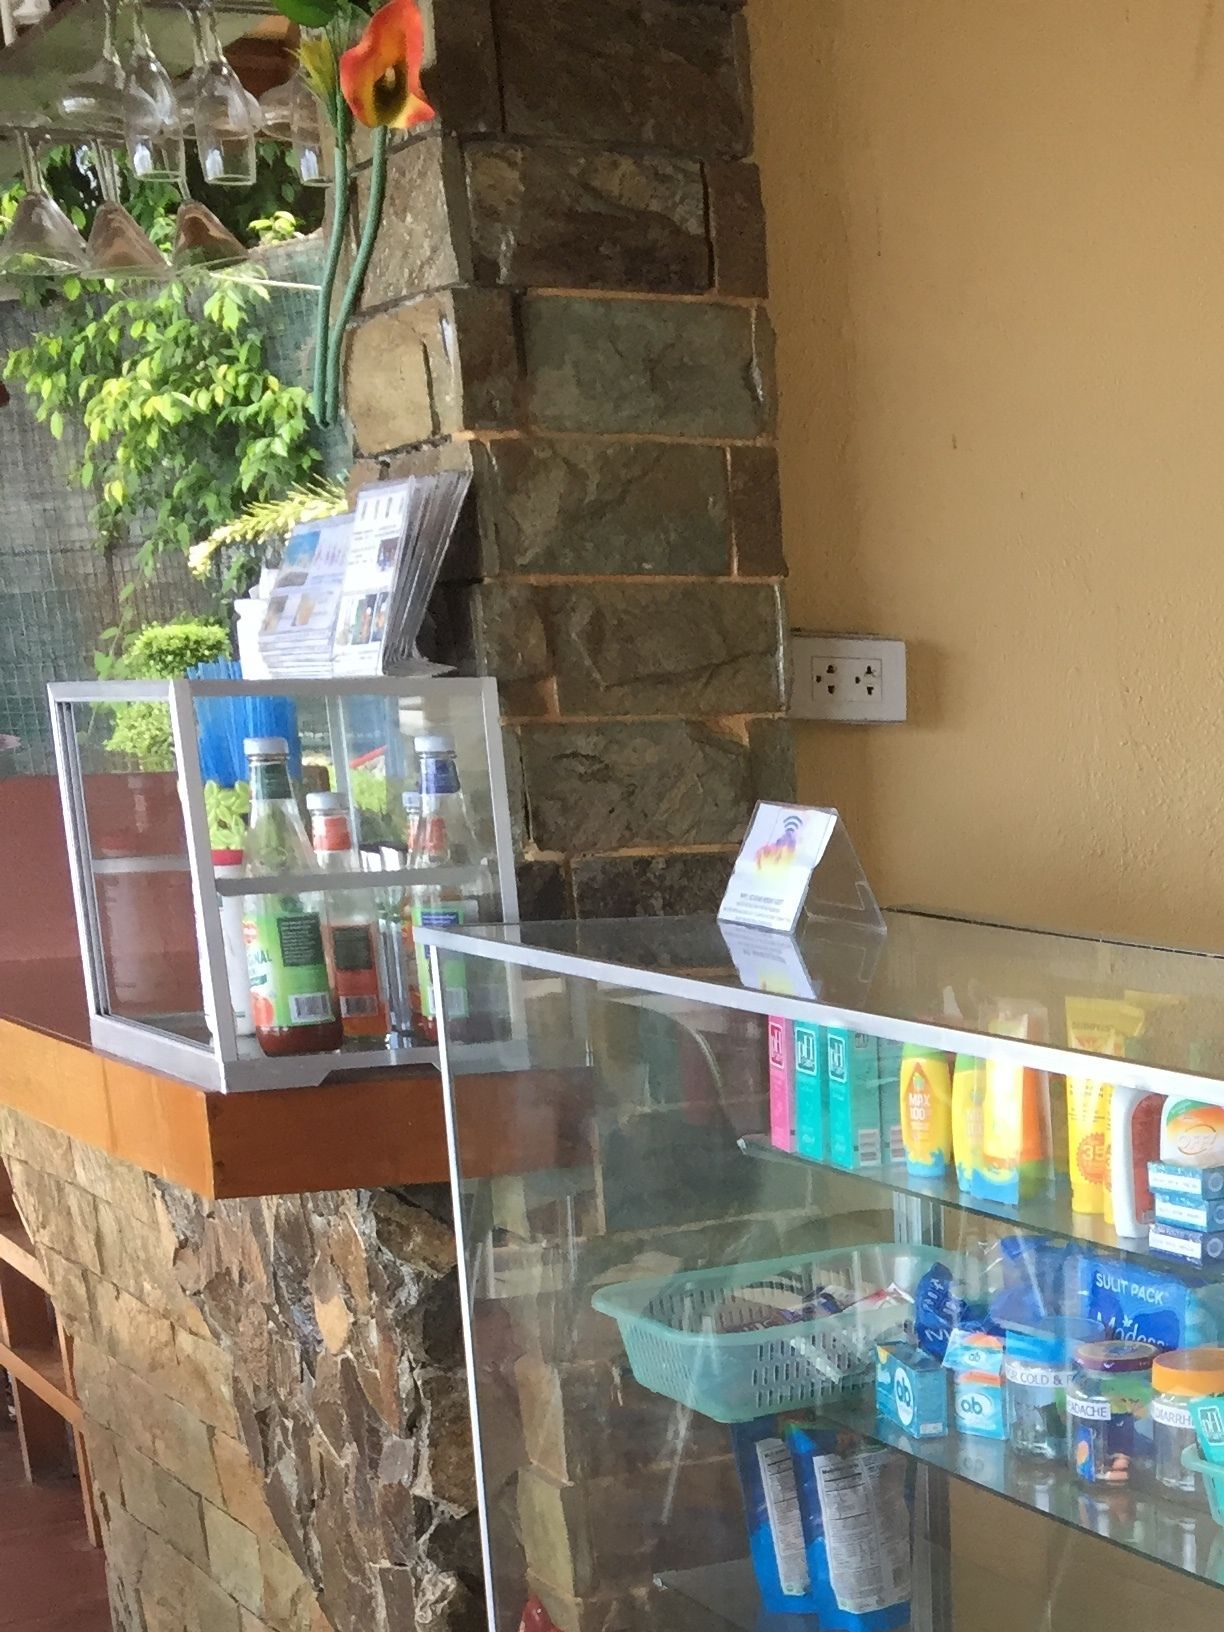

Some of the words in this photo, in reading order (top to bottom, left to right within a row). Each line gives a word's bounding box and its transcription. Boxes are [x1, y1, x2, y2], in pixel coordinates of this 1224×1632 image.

[1095, 1272, 1129, 1292] SULIT
[1130, 1283, 1165, 1304] PACK
[1020, 1372, 1050, 1386] COLD
[1053, 1374, 1063, 1386] &
[1071, 1402, 1108, 1418] ADACHE
[1155, 1408, 1192, 1426] DIARRH
